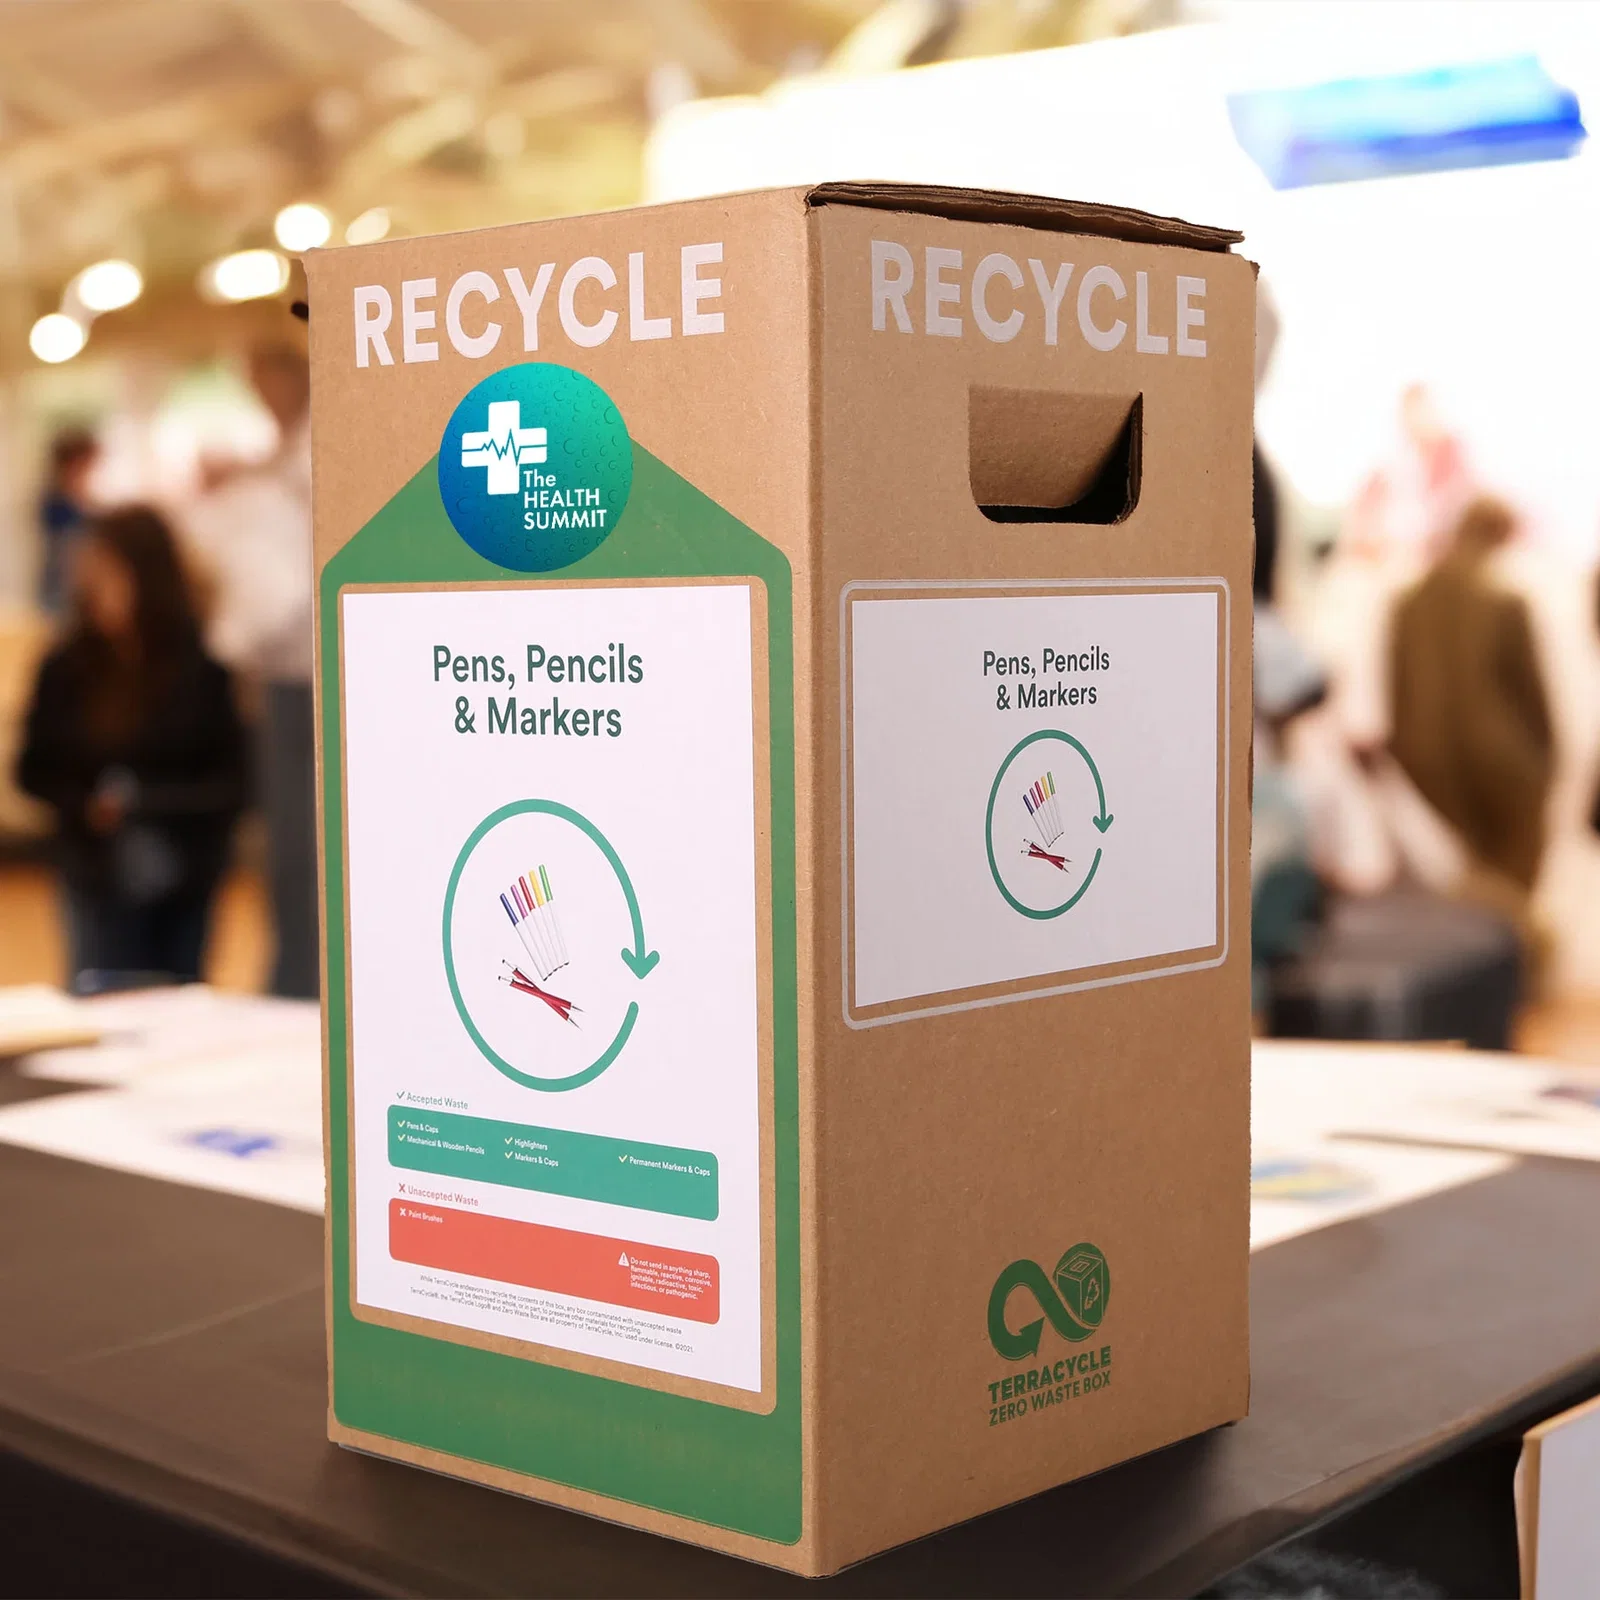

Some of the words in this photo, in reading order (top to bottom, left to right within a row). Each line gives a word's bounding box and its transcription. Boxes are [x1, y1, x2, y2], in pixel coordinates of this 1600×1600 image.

[354, 242, 725, 368] RECYCLE
[871, 240, 1207, 358] RECYCLE
[523, 469, 557, 488] The
[524, 488, 600, 509] HEALTH
[524, 509, 607, 530] SUMMIT
[433, 645, 515, 690] Pens,
[527, 642, 644, 683] Pencils
[983, 650, 1036, 679] Pens,
[1043, 645, 1110, 673] Pencils
[996, 684, 1011, 711] &
[1018, 681, 1097, 709] Markers
[454, 695, 477, 734] &
[487, 696, 622, 737] Markers
[407, 1092, 442, 1106] Accepted
[444, 1098, 469, 1110] Waste
[407, 1121, 419, 1131] Pens
[420, 1123, 424, 1131] &
[425, 1124, 439, 1134] Caps
[407, 1135, 437, 1147] Mechanical
[437, 1140, 442, 1148] &
[442, 1141, 465, 1152] Wooden
[465, 1145, 485, 1155] Pencils
[514, 1138, 548, 1151] Highlighters
[514, 1152, 538, 1164] Markers
[538, 1156, 543, 1164] &
[543, 1157, 559, 1167] Caps
[629, 1156, 661, 1169] Permanent
[662, 1161, 687, 1173] Markers
[688, 1165, 693, 1174] &
[694, 1166, 711, 1177] Caps
[408, 1185, 452, 1202] Unaccepted
[454, 1193, 479, 1207] Waste
[988, 1345, 1111, 1404] TERRACYCLE
[989, 1398, 1027, 1427] ZERO
[1031, 1380, 1080, 1411] WASTE
[1083, 1370, 1111, 1394] BOX
